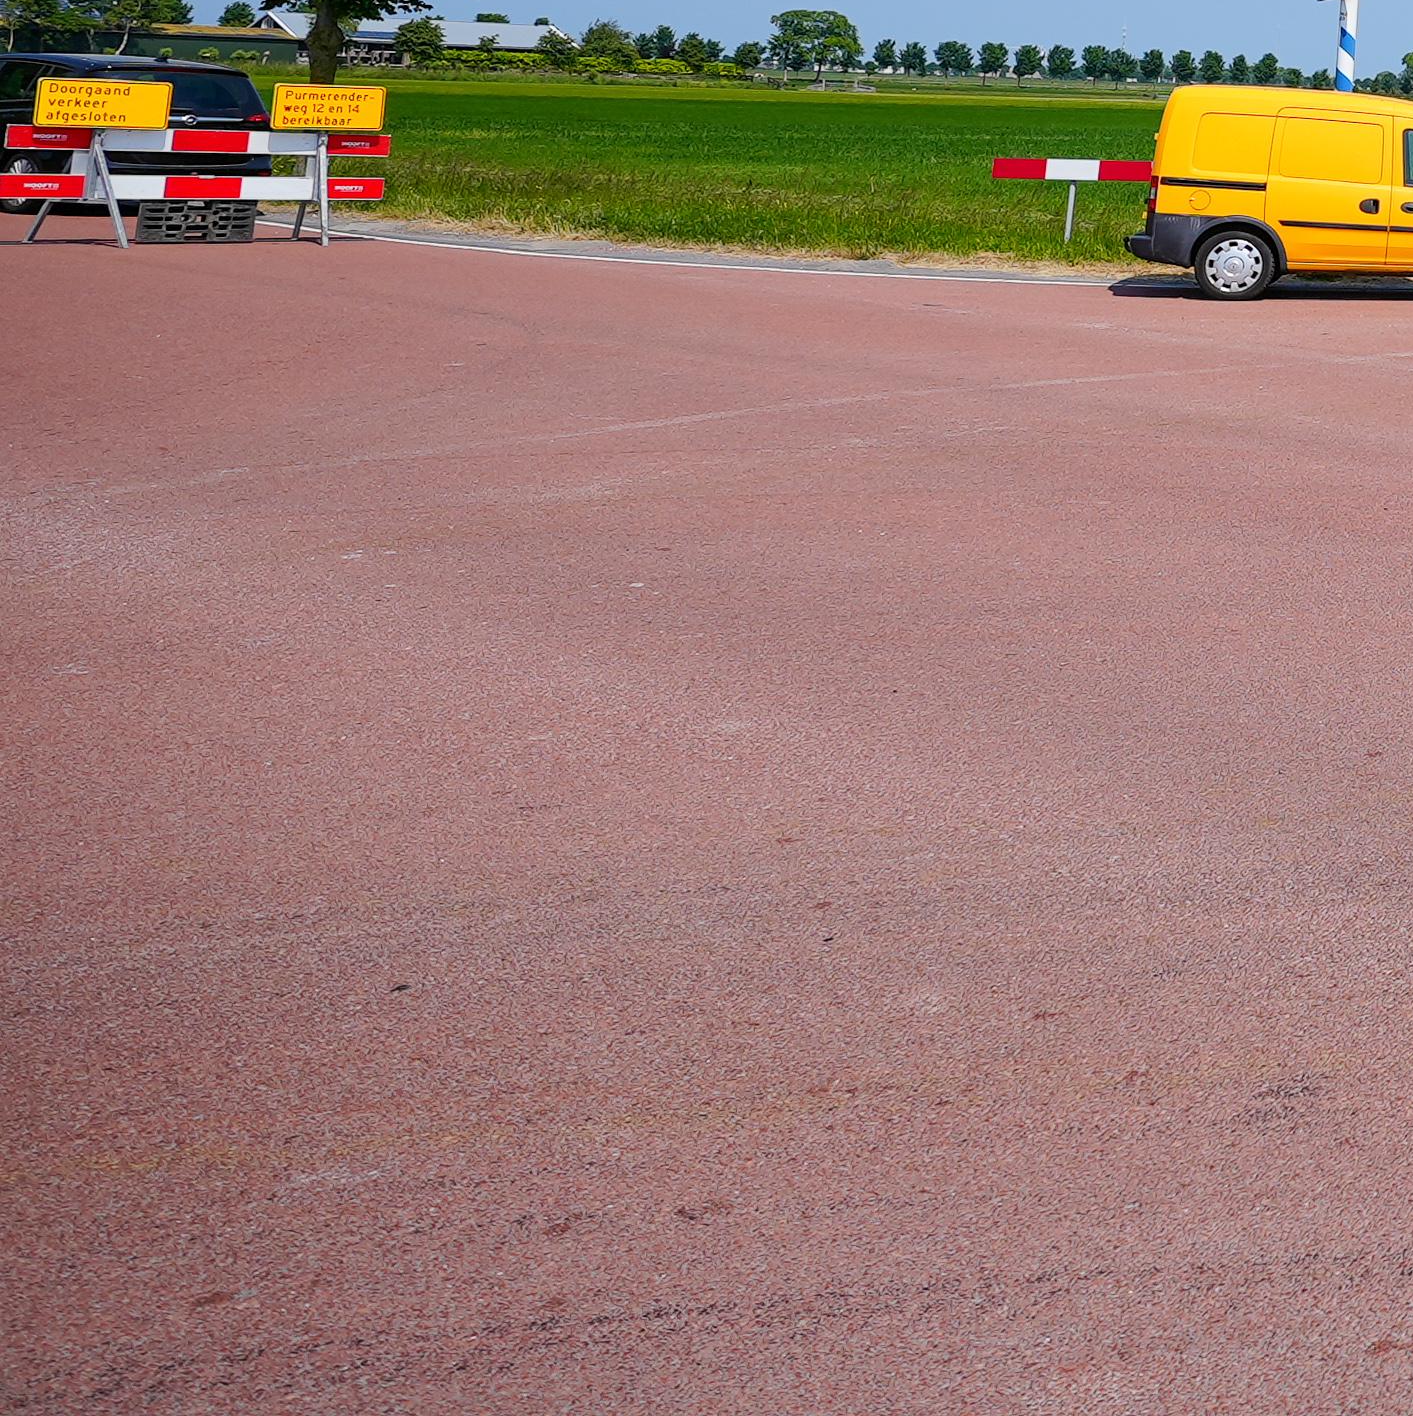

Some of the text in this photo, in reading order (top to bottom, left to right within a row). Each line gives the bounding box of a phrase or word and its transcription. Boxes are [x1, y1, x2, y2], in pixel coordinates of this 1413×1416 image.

[49, 82, 131, 97] Doorgaand
[285, 90, 375, 102] Purmerender-
[48, 98, 108, 109] verkeer
[283, 103, 360, 115] weg 12 en 14
[46, 110, 126, 123] afgesloten
[282, 116, 352, 126] bereikbaar
